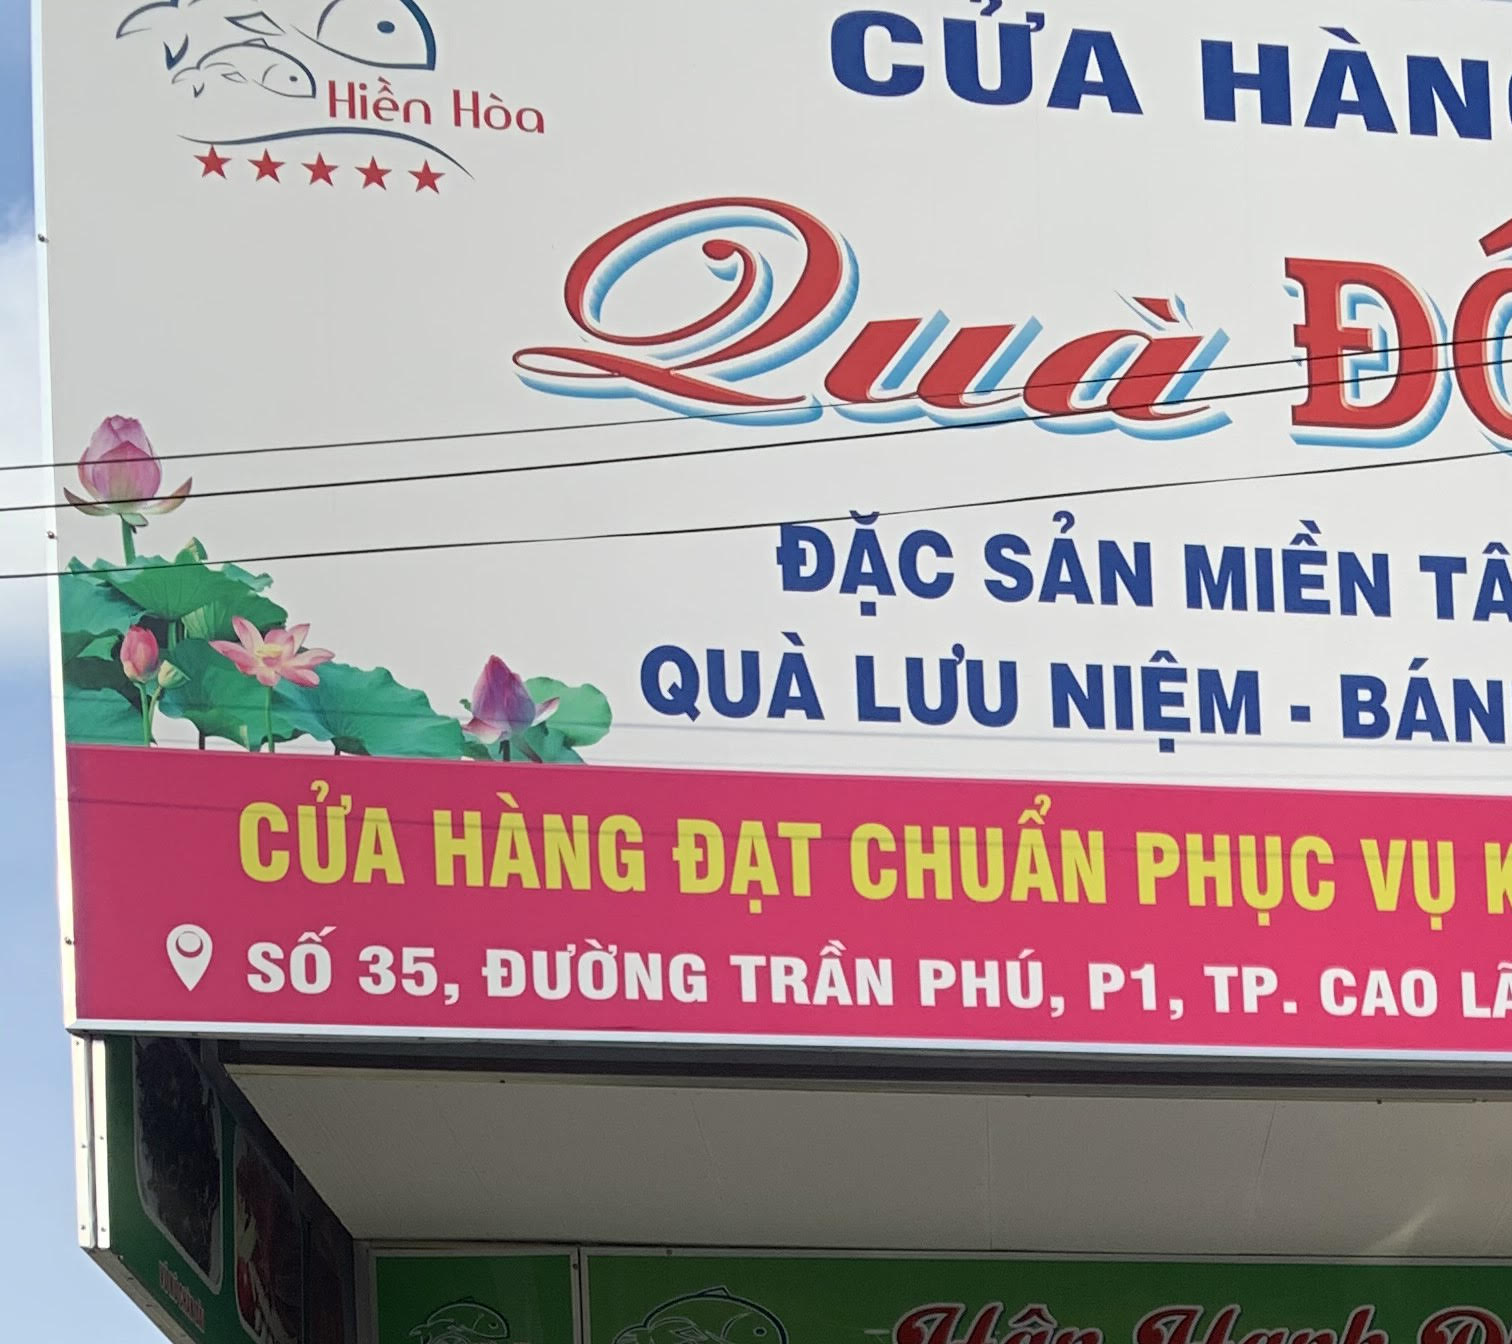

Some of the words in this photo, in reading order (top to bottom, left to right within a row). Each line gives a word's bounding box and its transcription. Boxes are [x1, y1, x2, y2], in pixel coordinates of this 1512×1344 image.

[327, 76, 432, 126] Hiền
[453, 88, 545, 134] Hòa
[831, 0, 1143, 115] CỬA
[513, 197, 1230, 440] Quà
[777, 510, 954, 616] ĐẶC
[984, 511, 1154, 607] SẢN
[1184, 519, 1391, 618] MIỀN
[640, 632, 825, 721] QUÀ
[855, 644, 1019, 728] LƯU
[1051, 650, 1261, 753] NIỆM
[1290, 705, 1311, 722] -
[239, 780, 405, 885] CỬA
[432, 792, 647, 893] HÀNG
[671, 818, 822, 913] ĐẠT
[850, 794, 1108, 904] CHUẨN
[1136, 832, 1336, 926] PHỤC
[1360, 840, 1456, 930] VỤ
[247, 926, 338, 995] SỐ
[358, 944, 460, 1005] 35,
[482, 938, 709, 1003] ĐƯỜNG
[730, 940, 894, 1006] TRẦN
[918, 949, 1066, 1018] PHÚ,
[1088, 963, 1184, 1020] P1,
[1204, 965, 1298, 1015] TP.
[1319, 968, 1438, 1018] CAO
